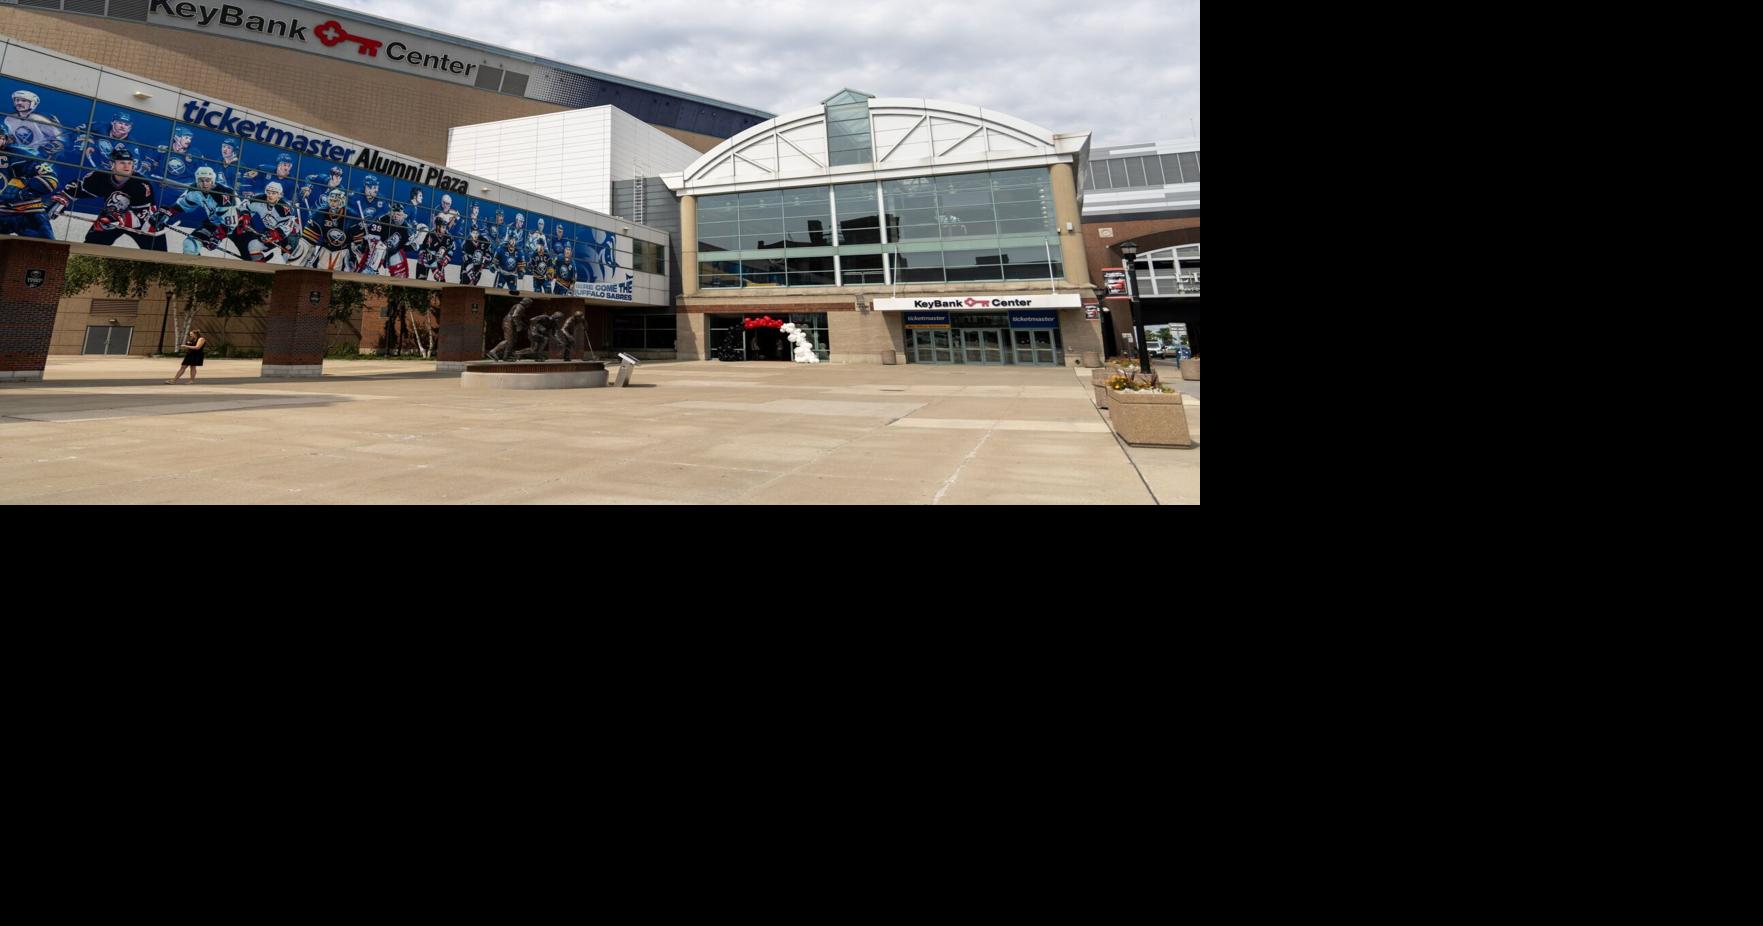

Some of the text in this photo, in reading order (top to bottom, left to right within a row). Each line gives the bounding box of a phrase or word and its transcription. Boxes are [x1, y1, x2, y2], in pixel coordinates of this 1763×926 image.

[149, 0, 477, 76] KeyBank Center
[184, 100, 469, 195] ticketmaster Alumni Plaza
[225, 216, 236, 226] 81
[595, 284, 618, 293] COME
[619, 280, 632, 294] THE
[914, 298, 1031, 309] KeyBank Center
